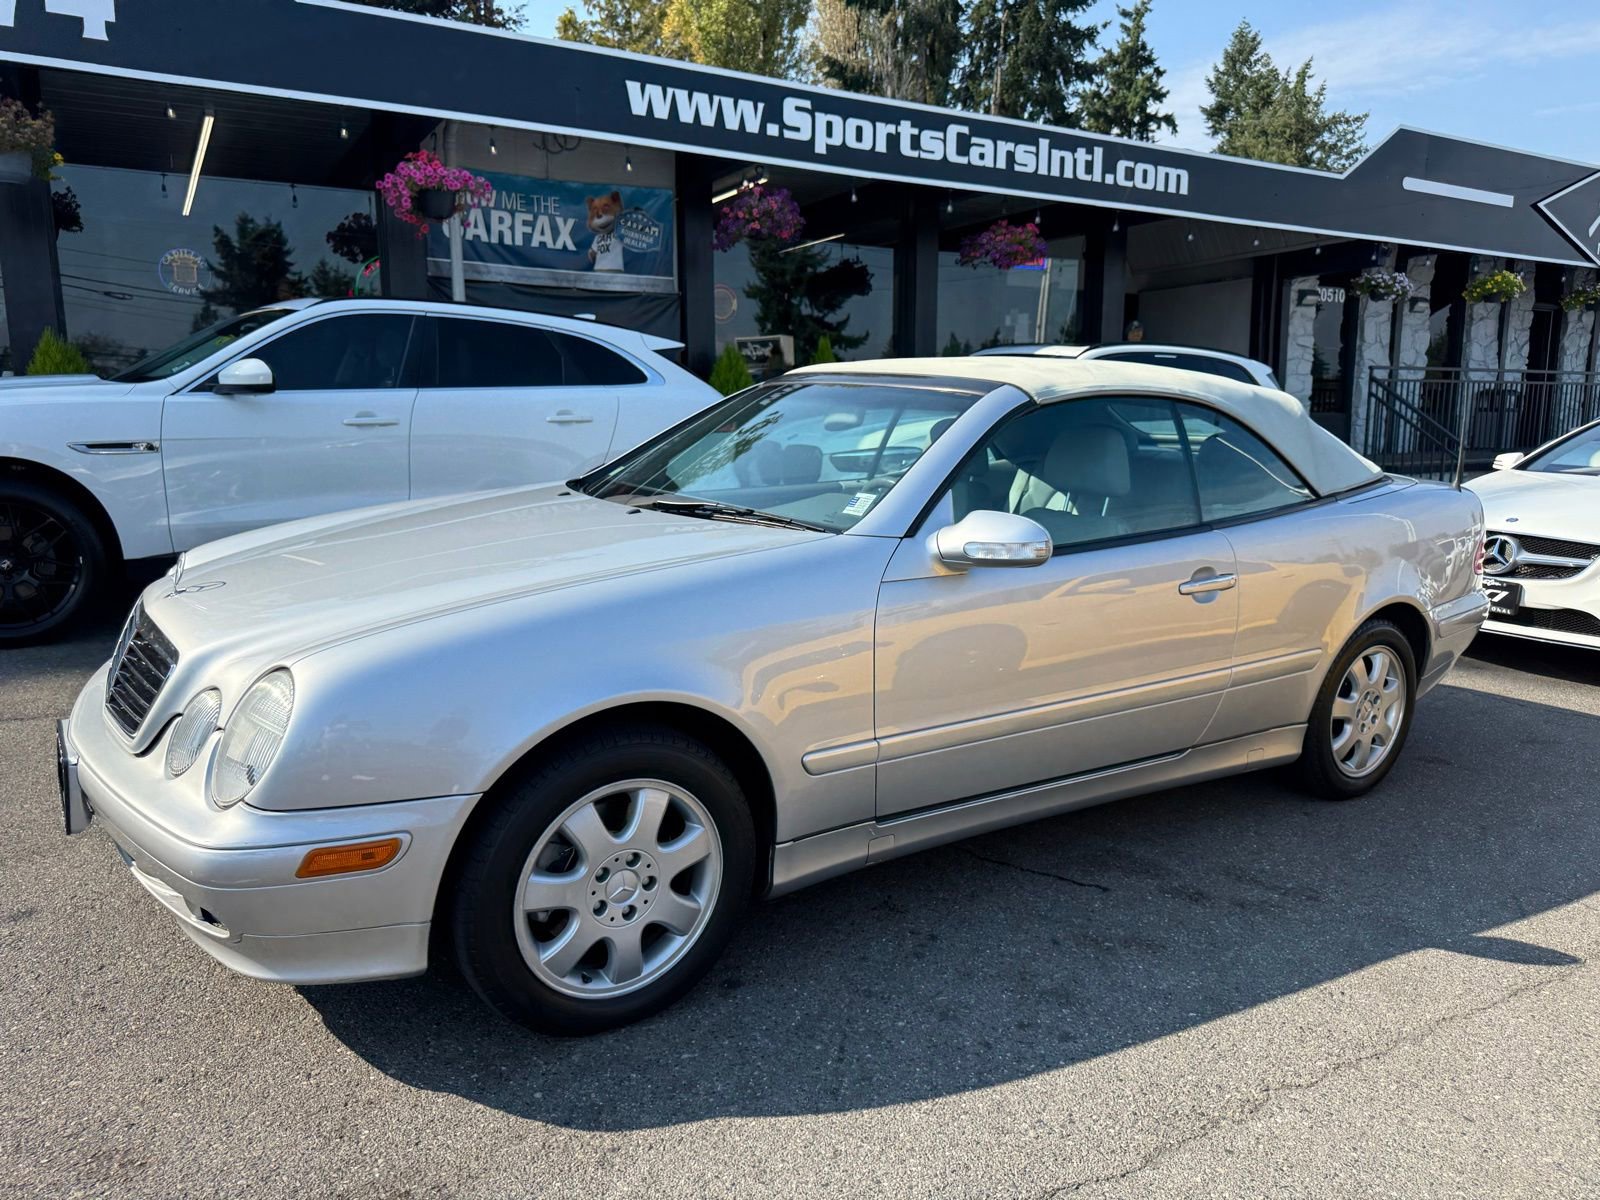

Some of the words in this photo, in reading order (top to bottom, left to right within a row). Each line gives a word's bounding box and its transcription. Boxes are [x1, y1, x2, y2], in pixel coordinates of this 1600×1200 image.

[625, 80, 1189, 195] www.SportsCarsIntl.com
[502, 190, 527, 211] ME
[530, 194, 560, 215] THE
